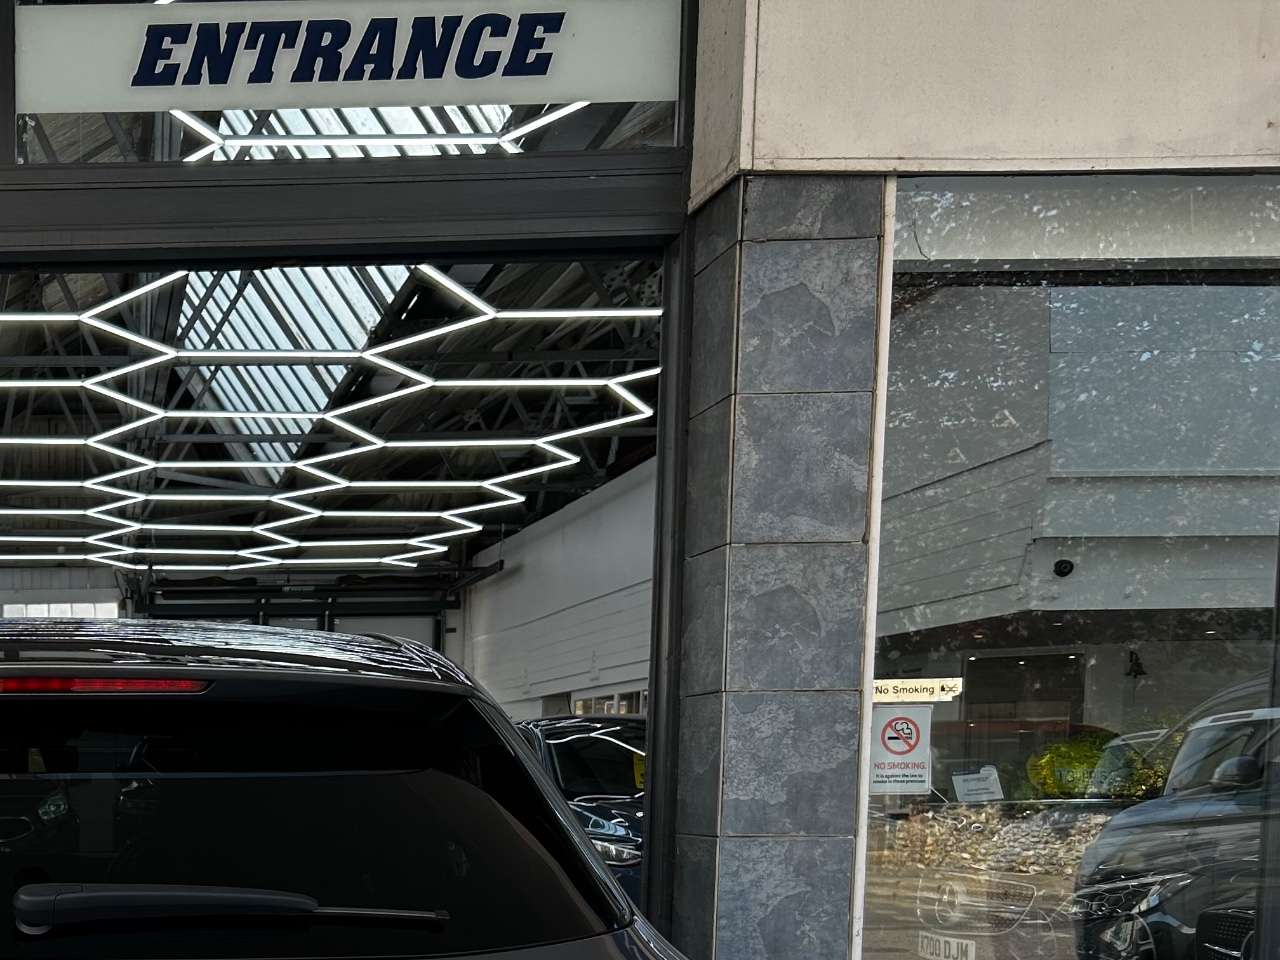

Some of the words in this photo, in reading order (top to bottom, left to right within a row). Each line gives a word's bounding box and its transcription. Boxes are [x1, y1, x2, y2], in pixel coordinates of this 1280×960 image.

[131, 12, 566, 87] ENTRANCE
[874, 686, 889, 694] No
[892, 685, 935, 695] Smoking
[873, 761, 886, 770] NO
